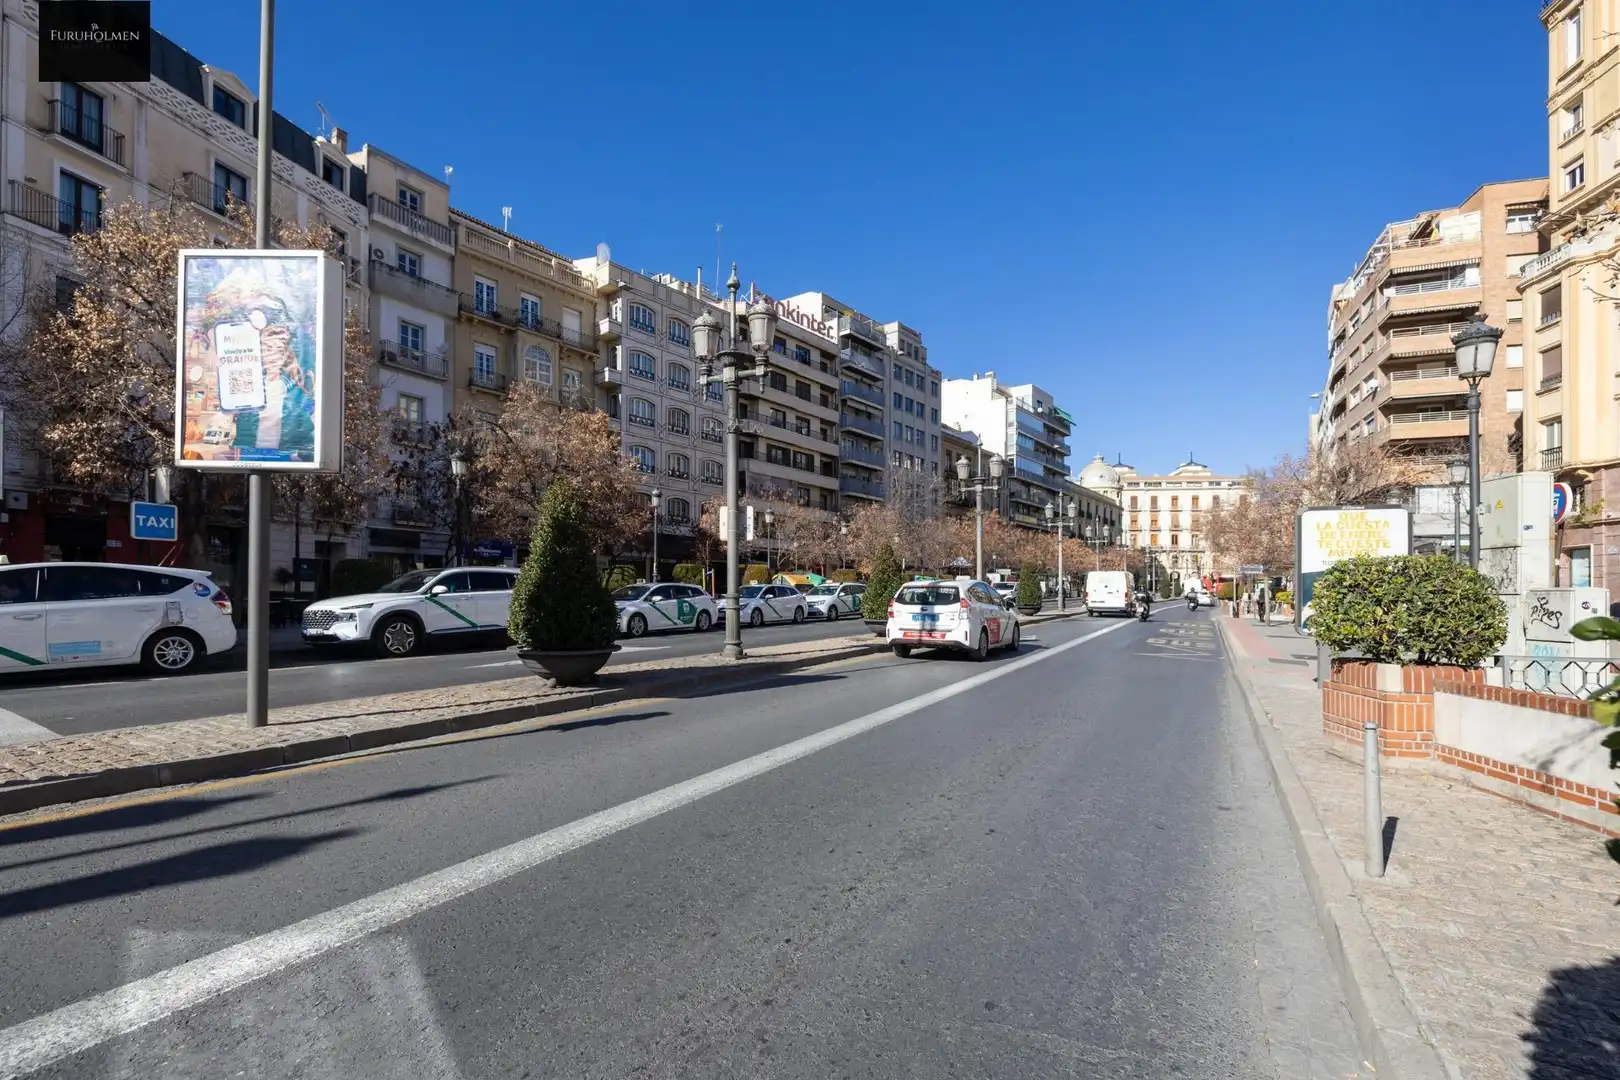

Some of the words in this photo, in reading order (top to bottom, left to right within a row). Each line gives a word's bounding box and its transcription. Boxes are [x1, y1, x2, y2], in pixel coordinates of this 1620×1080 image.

[136, 515, 174, 528] TAXI
[1316, 520, 1332, 530] LA
[1336, 520, 1390, 530] CUESTA
[1320, 530, 1336, 539] DE
[1317, 540, 1332, 548] TE
[1336, 540, 1391, 548] CUESTE
